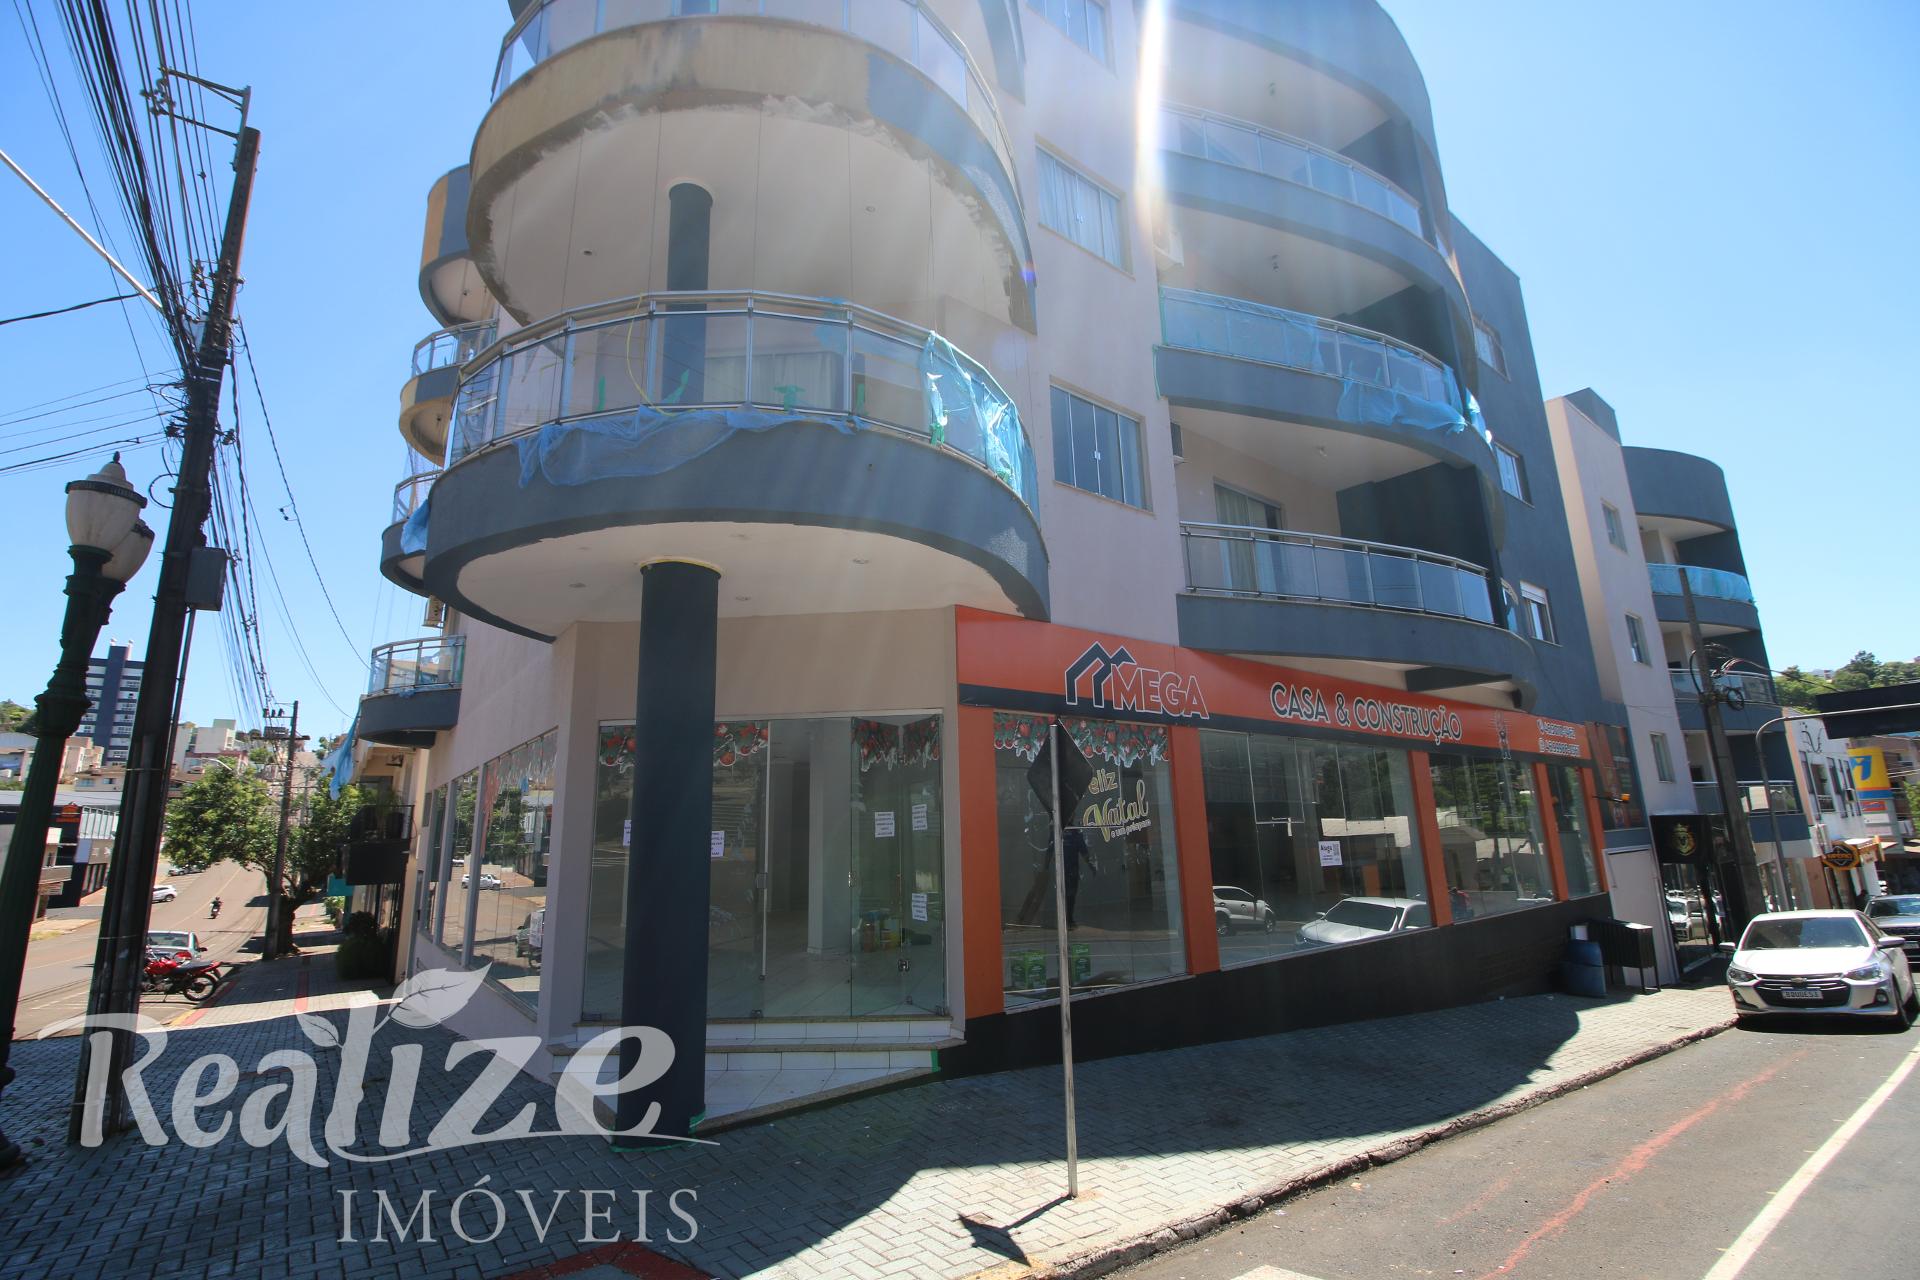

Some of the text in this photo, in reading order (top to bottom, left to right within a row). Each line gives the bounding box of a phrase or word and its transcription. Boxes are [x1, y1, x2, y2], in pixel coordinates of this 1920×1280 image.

[1111, 663, 1210, 720] MEGA
[1270, 681, 1463, 746] CASA & CONSTRUÇÃO
[1083, 779, 1149, 842] Natal
[1088, 768, 1118, 794] eliz
